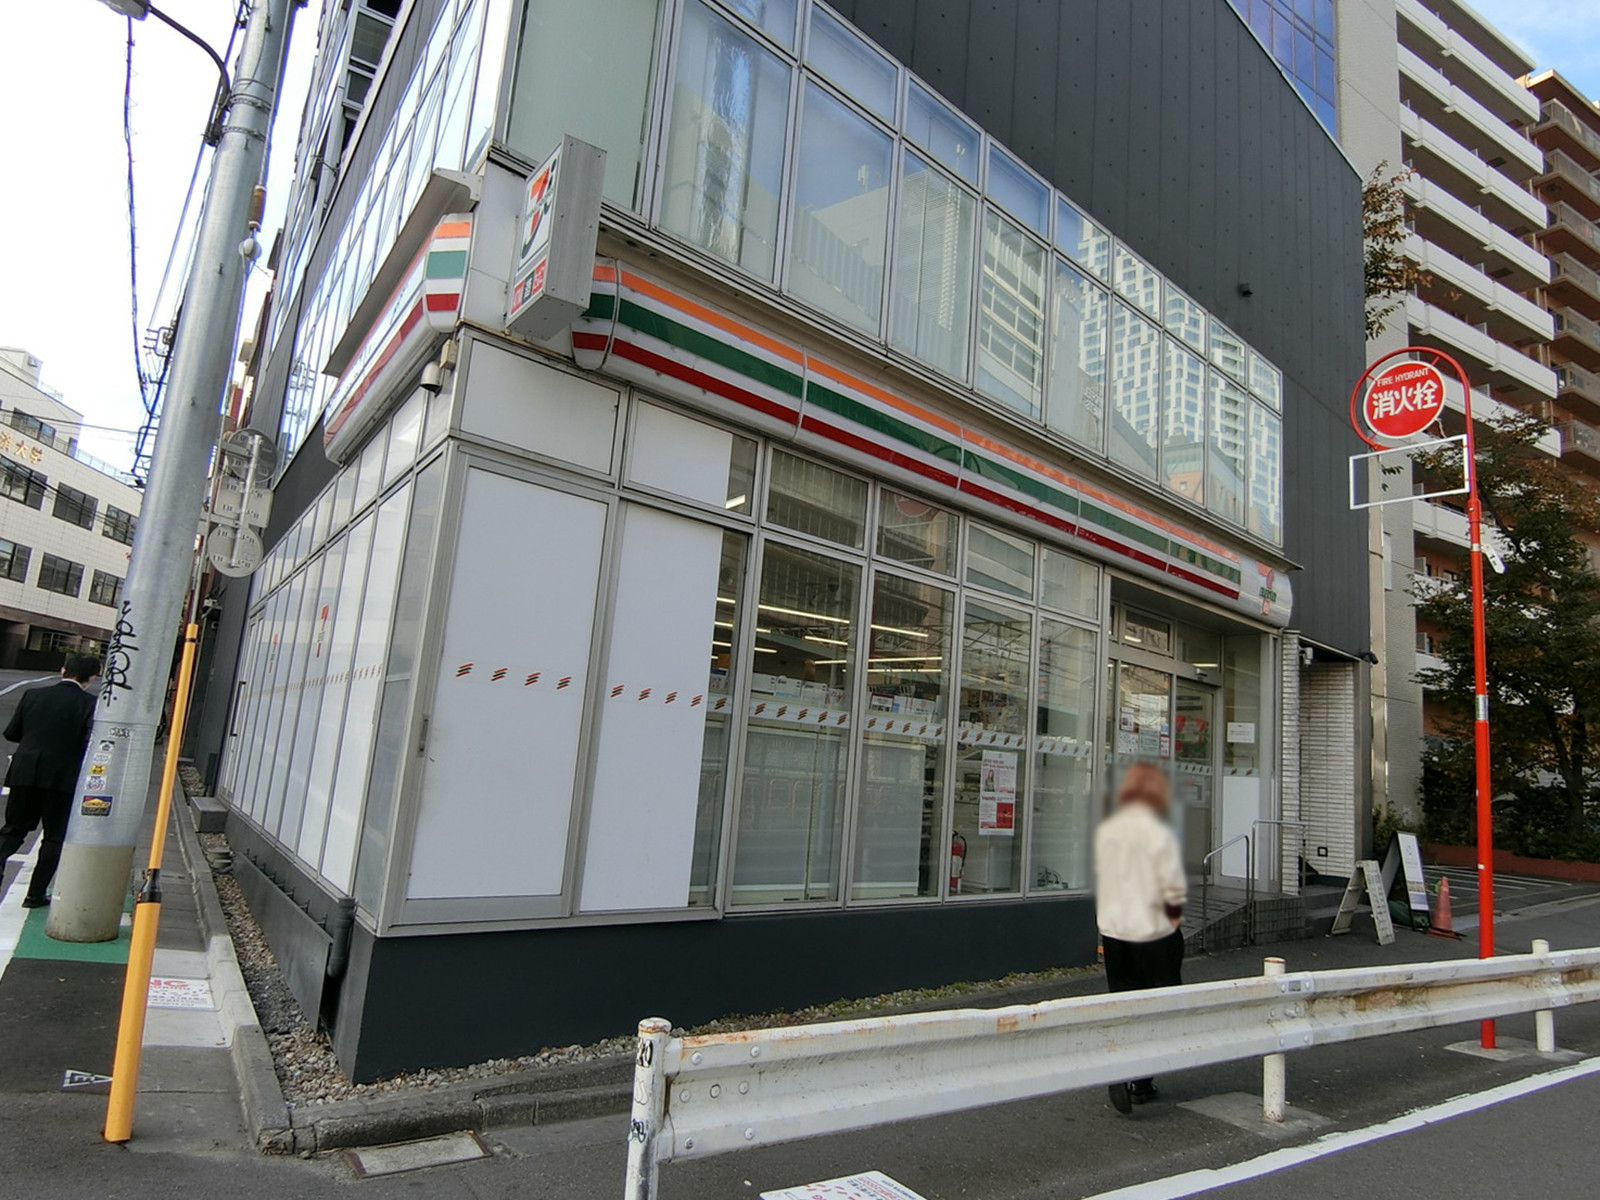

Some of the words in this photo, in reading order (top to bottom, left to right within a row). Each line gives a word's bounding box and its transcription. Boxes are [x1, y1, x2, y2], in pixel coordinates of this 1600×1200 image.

[1377, 375, 1393, 387] FIRE
[1394, 368, 1430, 383] HYDRANT
[1372, 379, 1438, 420] 消火栓
